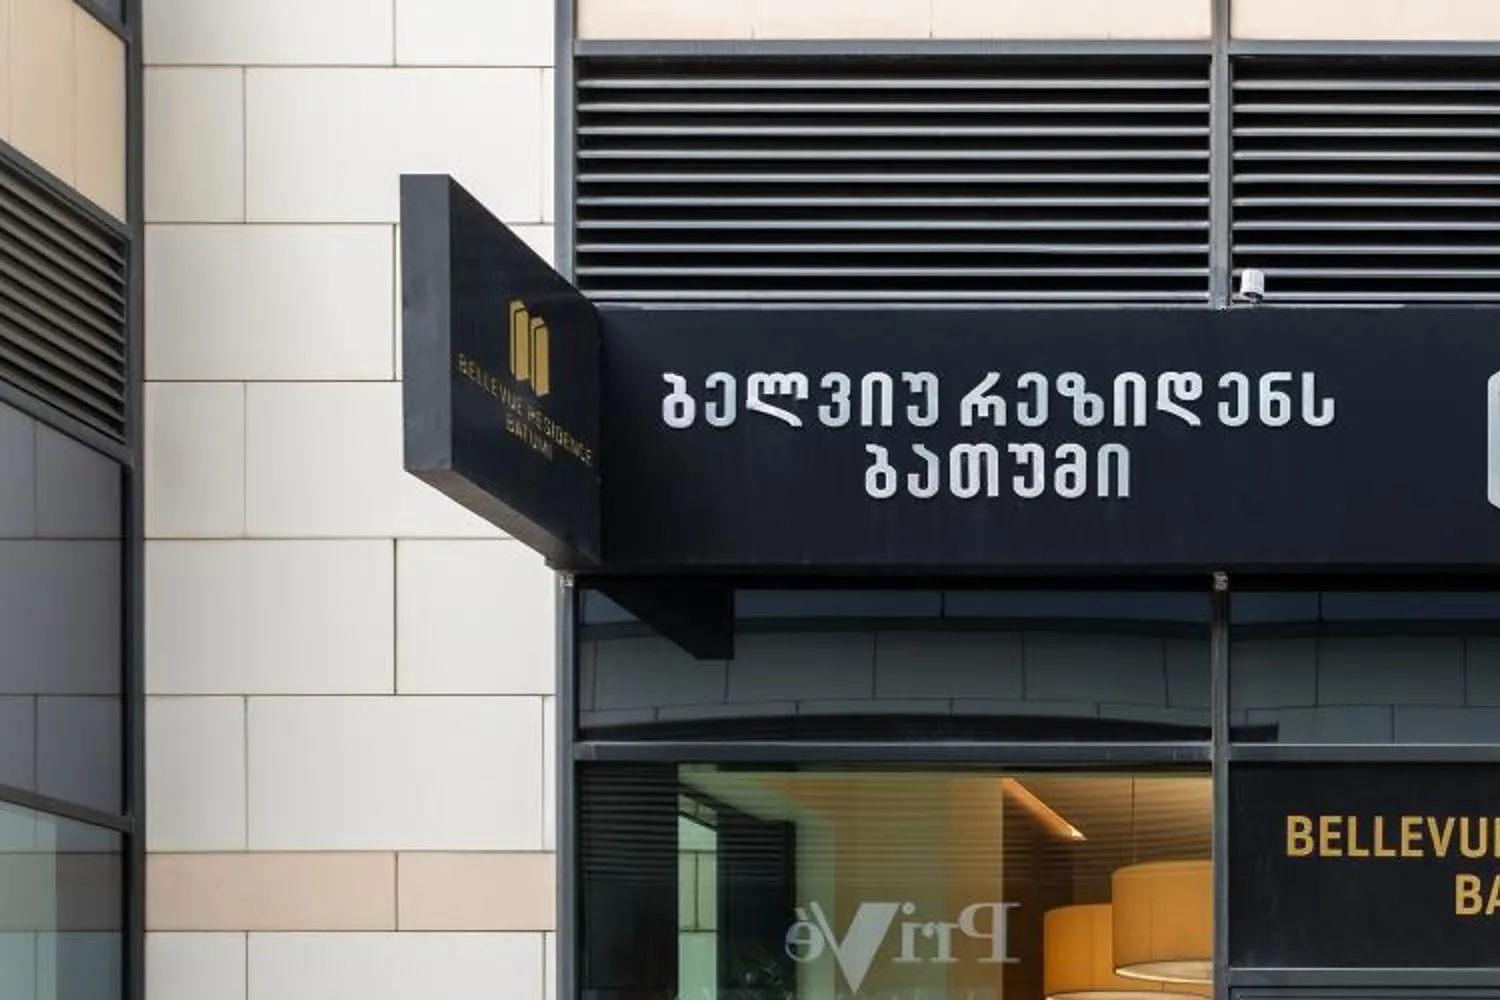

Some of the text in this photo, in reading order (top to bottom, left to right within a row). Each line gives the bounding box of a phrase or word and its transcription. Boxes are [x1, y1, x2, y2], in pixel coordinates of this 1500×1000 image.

[661, 371, 1336, 429] ბელვიუ რეზიდენს
[864, 442, 1132, 501] ბათუმი
